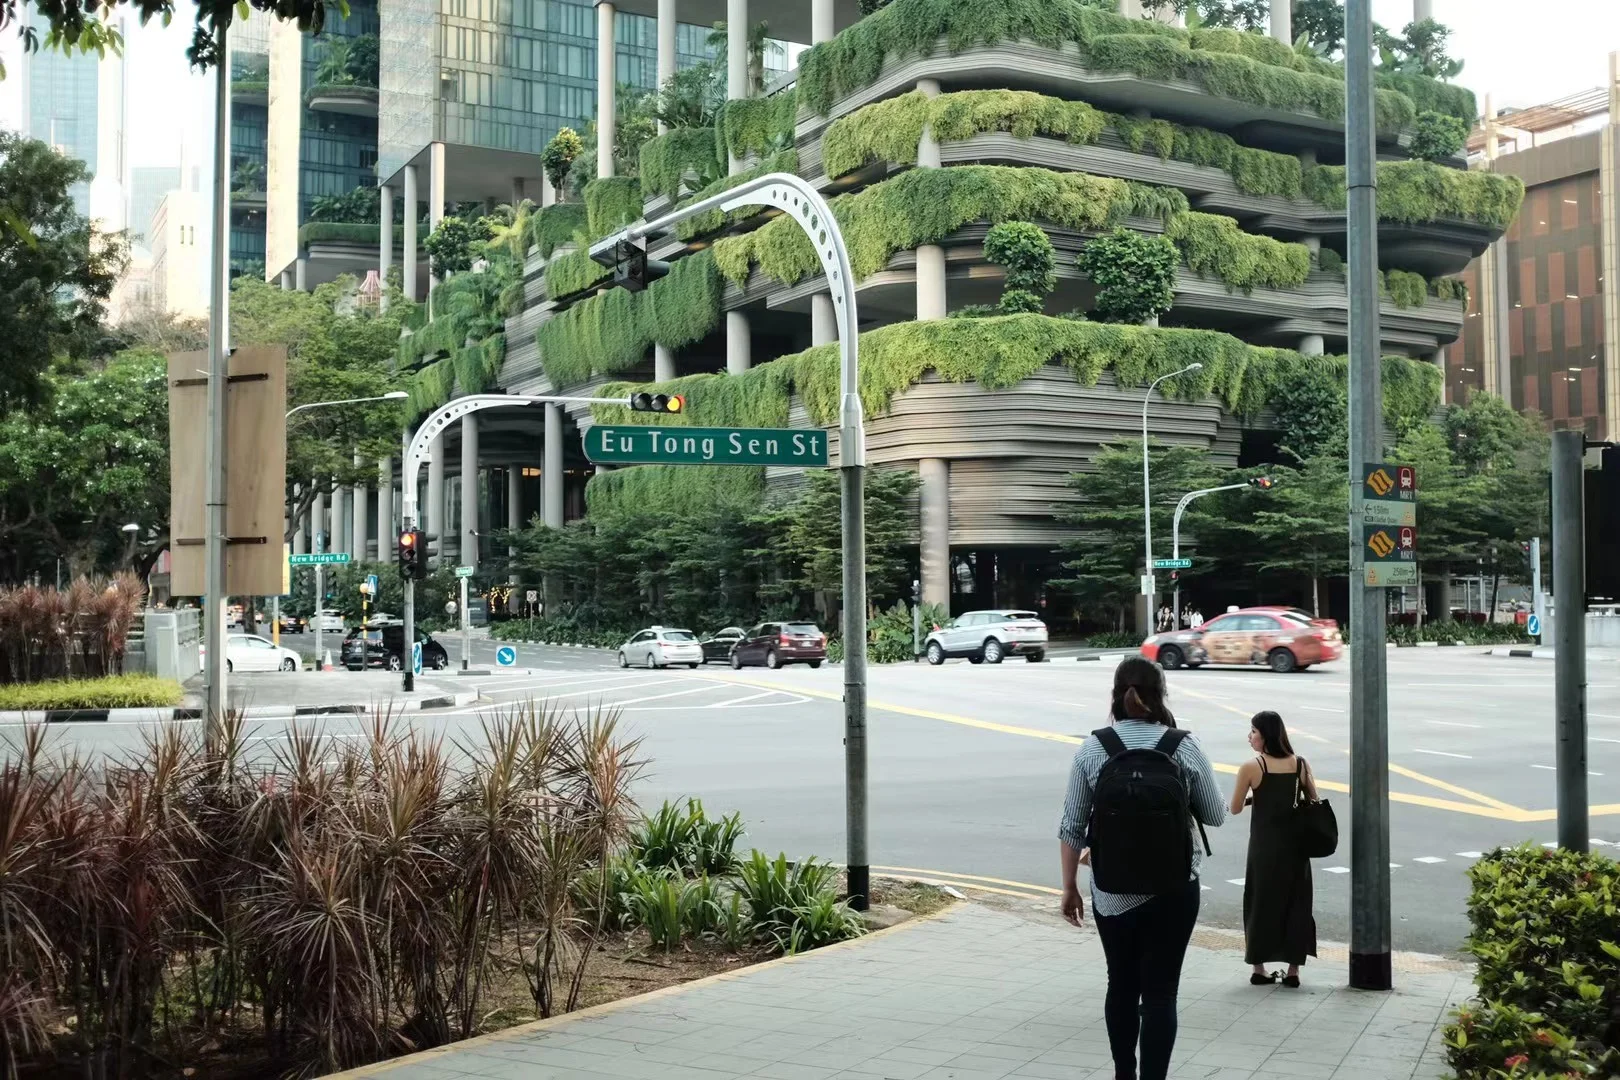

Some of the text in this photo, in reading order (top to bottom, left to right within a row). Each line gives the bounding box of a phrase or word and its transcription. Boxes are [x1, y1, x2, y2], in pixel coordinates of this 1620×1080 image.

[601, 430, 820, 460] Eu Tong Sen St
[1400, 490, 1413, 500] MRT
[310, 554, 334, 562] Bridge
[1400, 550, 1413, 560] MRT
